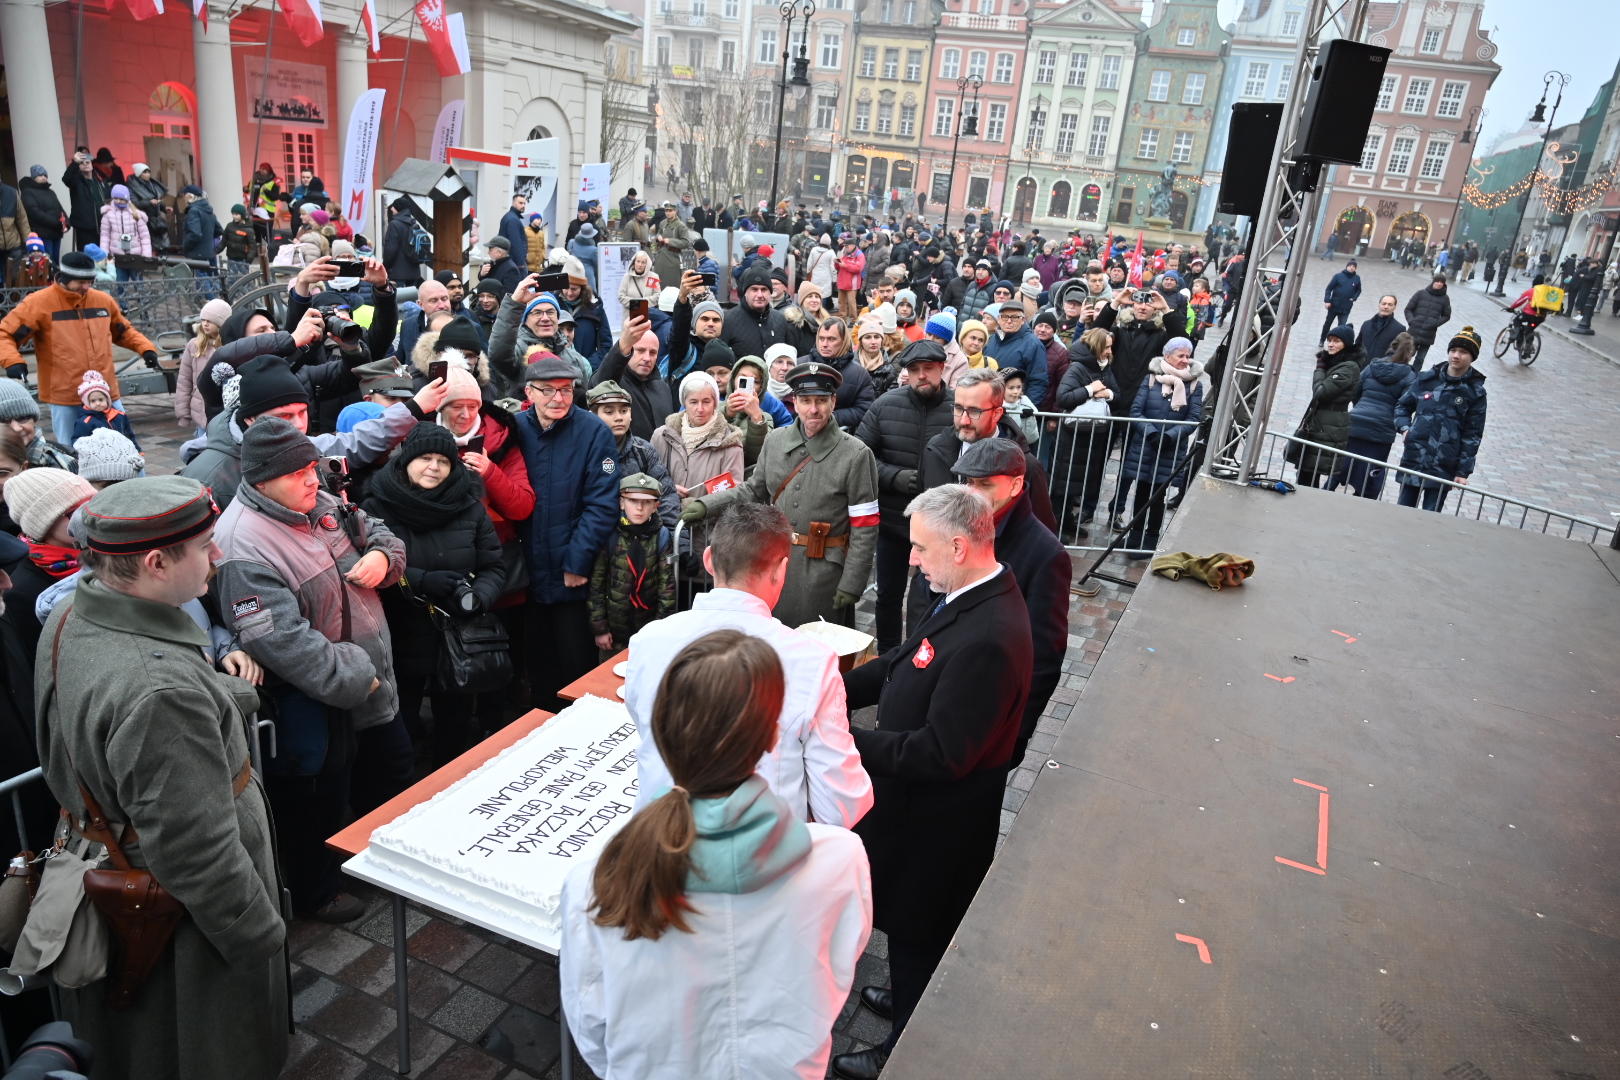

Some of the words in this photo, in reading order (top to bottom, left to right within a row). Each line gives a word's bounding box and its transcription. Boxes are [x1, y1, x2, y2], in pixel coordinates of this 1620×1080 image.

[469, 746, 578, 820] WIELKOPOLANIE
[539, 769, 586, 799] PANIE
[570, 781, 607, 802] GEN.
[508, 805, 587, 854] TACZAKA
[548, 800, 632, 858] ROCZNICA
